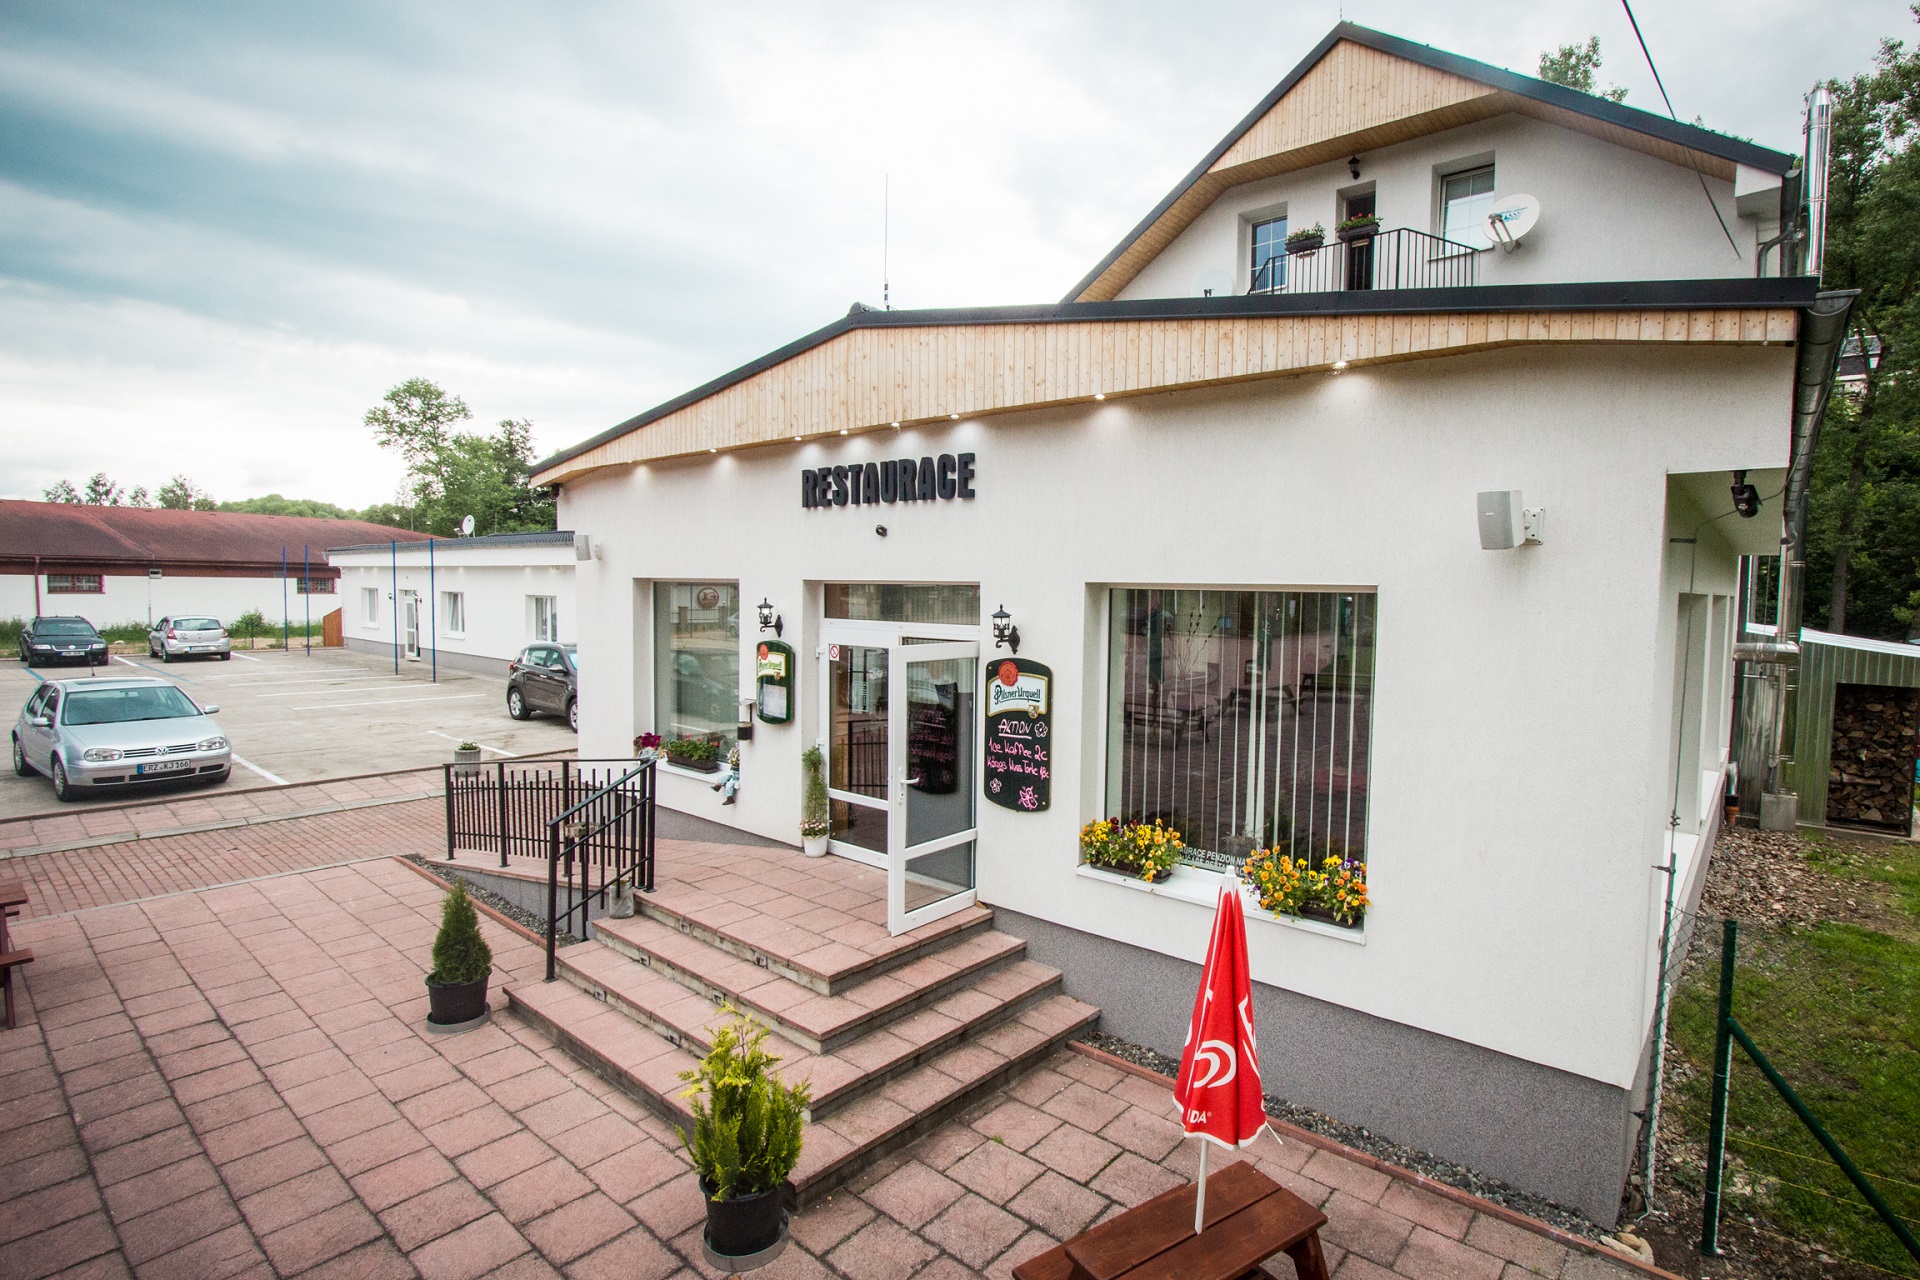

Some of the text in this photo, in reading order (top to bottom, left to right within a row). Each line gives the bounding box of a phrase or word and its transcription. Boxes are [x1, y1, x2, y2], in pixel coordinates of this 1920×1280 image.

[801, 452, 976, 508] RESTAURACE
[994, 684, 1041, 705] Pilsner Urquell
[1180, 847, 1206, 859] AURACE
[1206, 850, 1236, 865] PENZION
